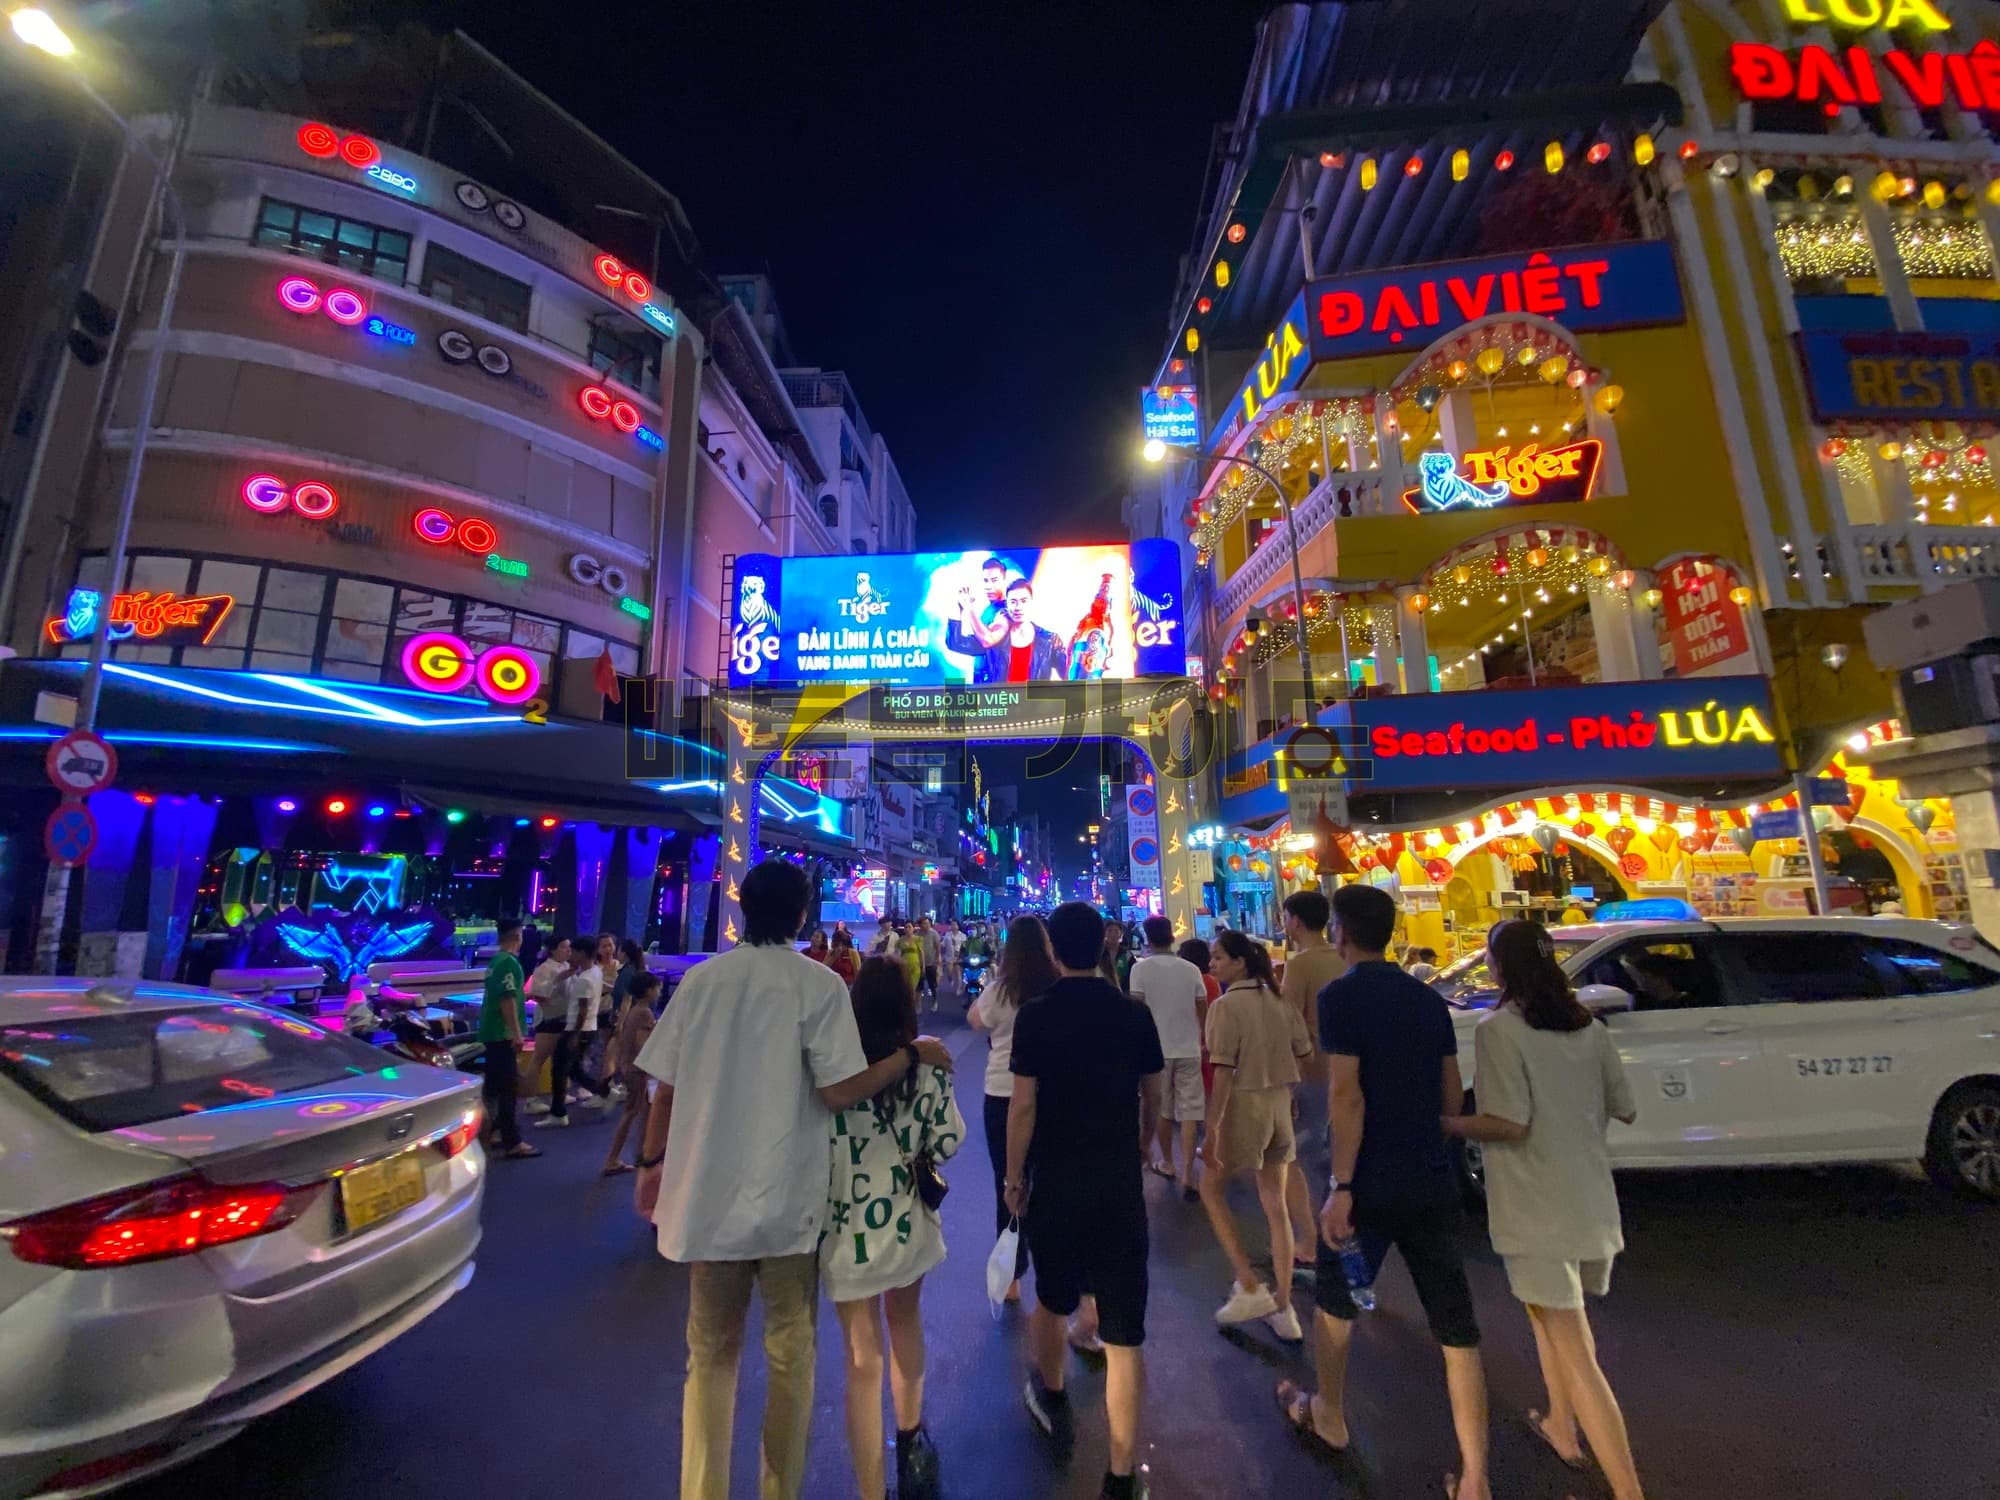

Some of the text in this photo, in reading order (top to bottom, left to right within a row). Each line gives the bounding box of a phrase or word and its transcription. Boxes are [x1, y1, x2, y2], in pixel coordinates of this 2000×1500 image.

[297, 122, 381, 169] GO
[277, 275, 368, 326] GO
[1318, 280, 1440, 343] ĐẠI
[1242, 321, 1304, 422] LÚA
[1146, 411, 1195, 423] Seafood
[1463, 443, 1582, 496] Tiger
[241, 472, 339, 520] GO
[414, 508, 498, 554] GO
[109, 591, 208, 637] Tiger
[838, 597, 890, 624] Tiger
[1135, 619, 1177, 648] er
[731, 622, 780, 675] ige
[872, 627, 884, 649] Á
[401, 632, 540, 704] GO
[797, 655, 831, 670] VANG
[833, 654, 867, 670] DANH
[523, 698, 548, 724] 2
[883, 691, 1019, 709] PHỐ ĐI BỘ BÙI VIỆN
[912, 710, 933, 719] VIEN
[936, 709, 976, 718] WALKING
[978, 707, 1008, 717] STREET
[1371, 719, 1538, 758] Seafood
[1569, 711, 1657, 750] Phở
[1658, 701, 1775, 747] LÚA
[1797, 1055, 1893, 1077] 54 27 27 27
